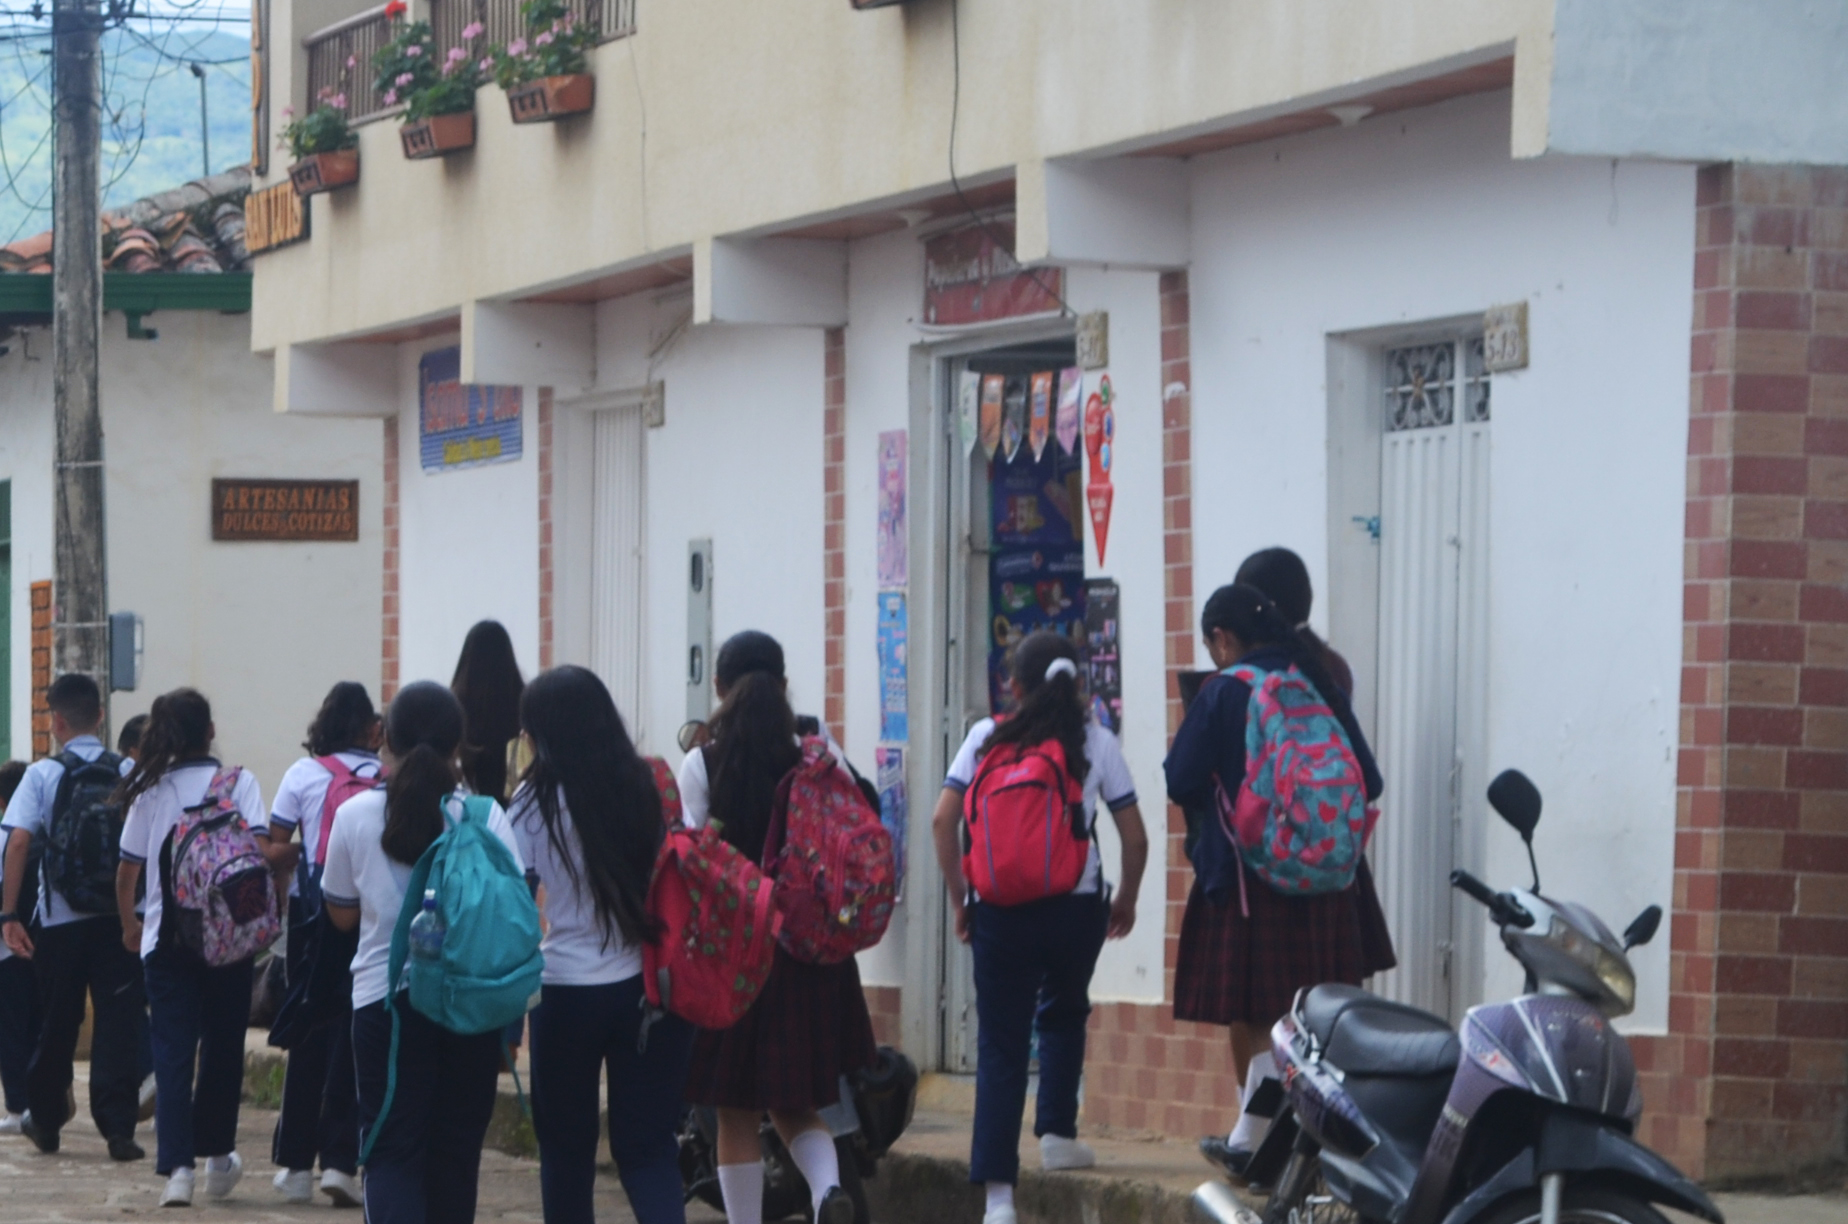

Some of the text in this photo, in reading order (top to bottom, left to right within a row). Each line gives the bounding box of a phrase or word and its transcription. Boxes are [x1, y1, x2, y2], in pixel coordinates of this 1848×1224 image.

[222, 486, 350, 511] ARTESANIAS
[222, 511, 280, 532] DULCES
[288, 511, 352, 532] COTIZAS
